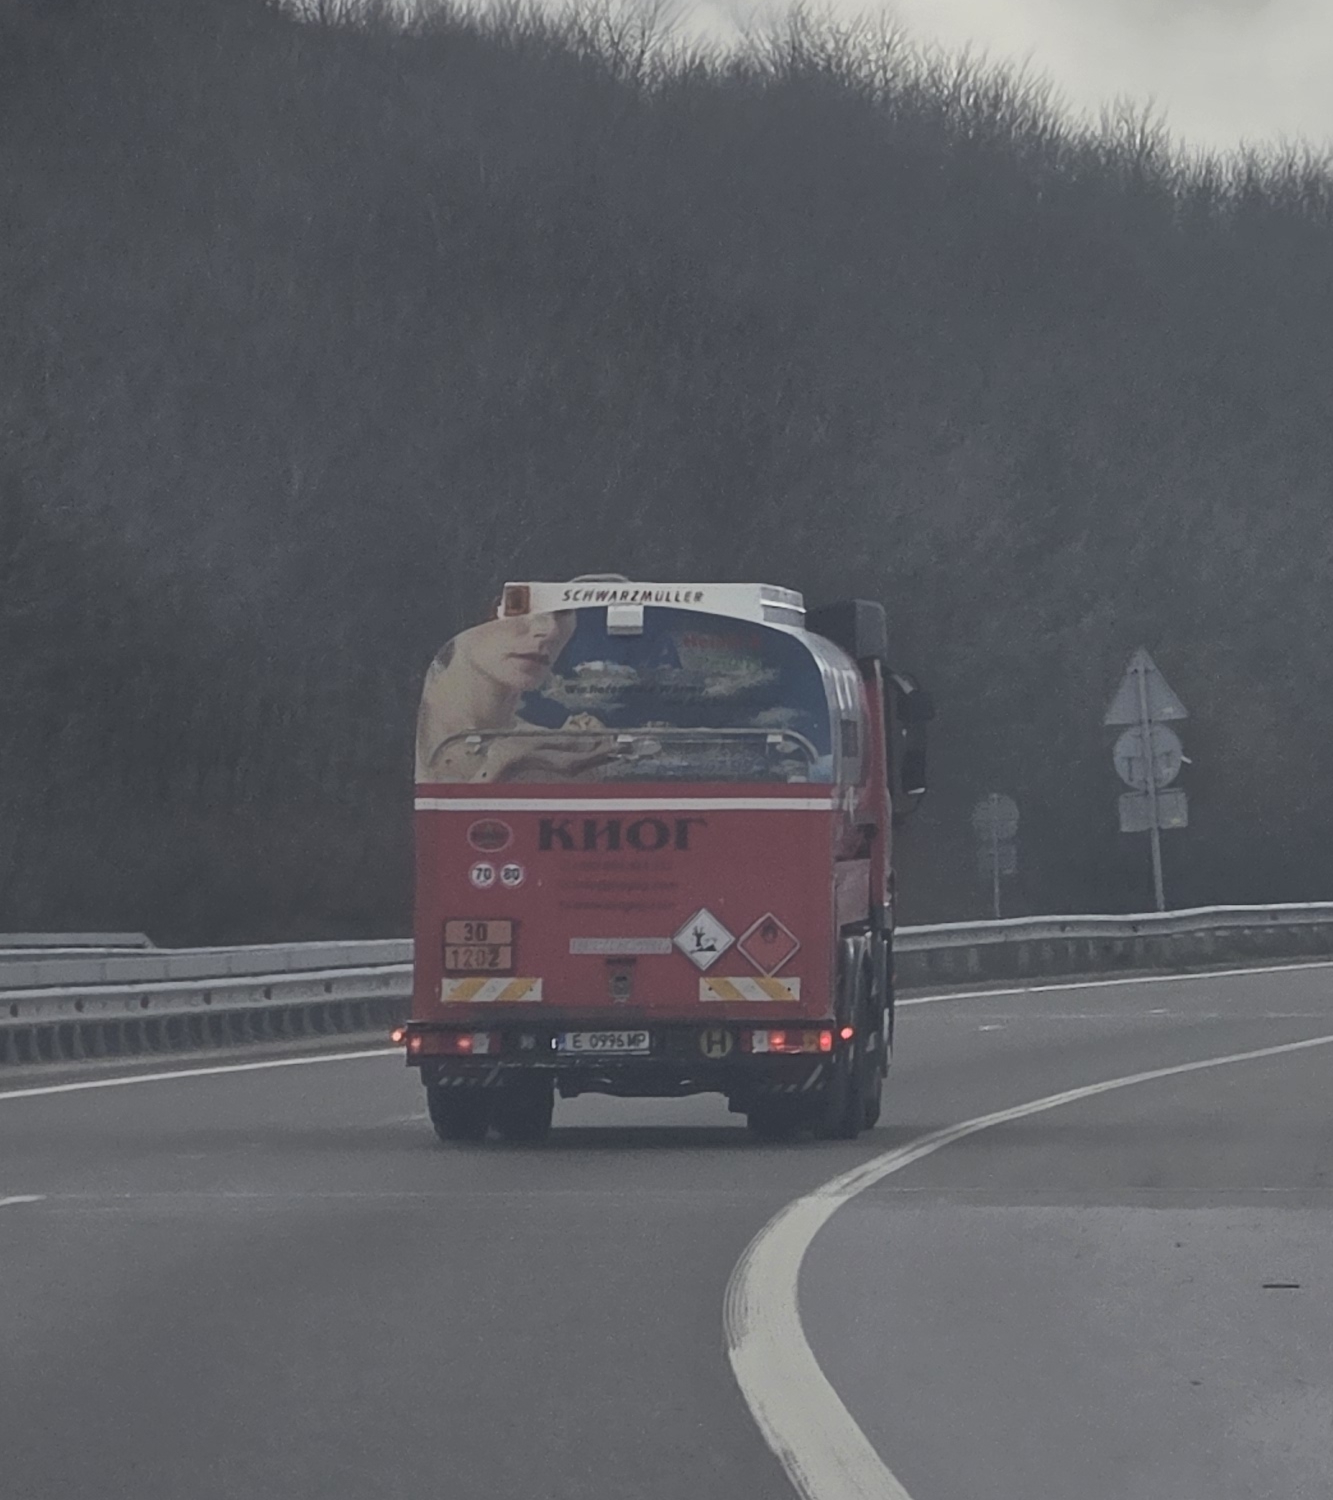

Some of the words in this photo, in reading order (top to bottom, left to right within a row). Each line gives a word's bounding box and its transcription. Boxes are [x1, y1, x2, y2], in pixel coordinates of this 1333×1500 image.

[475, 867, 492, 880] 70
[503, 867, 520, 881] 80
[464, 922, 488, 942] 30
[452, 946, 500, 968] 1202
[572, 1034, 583, 1048] E
[706, 1031, 726, 1054] H
